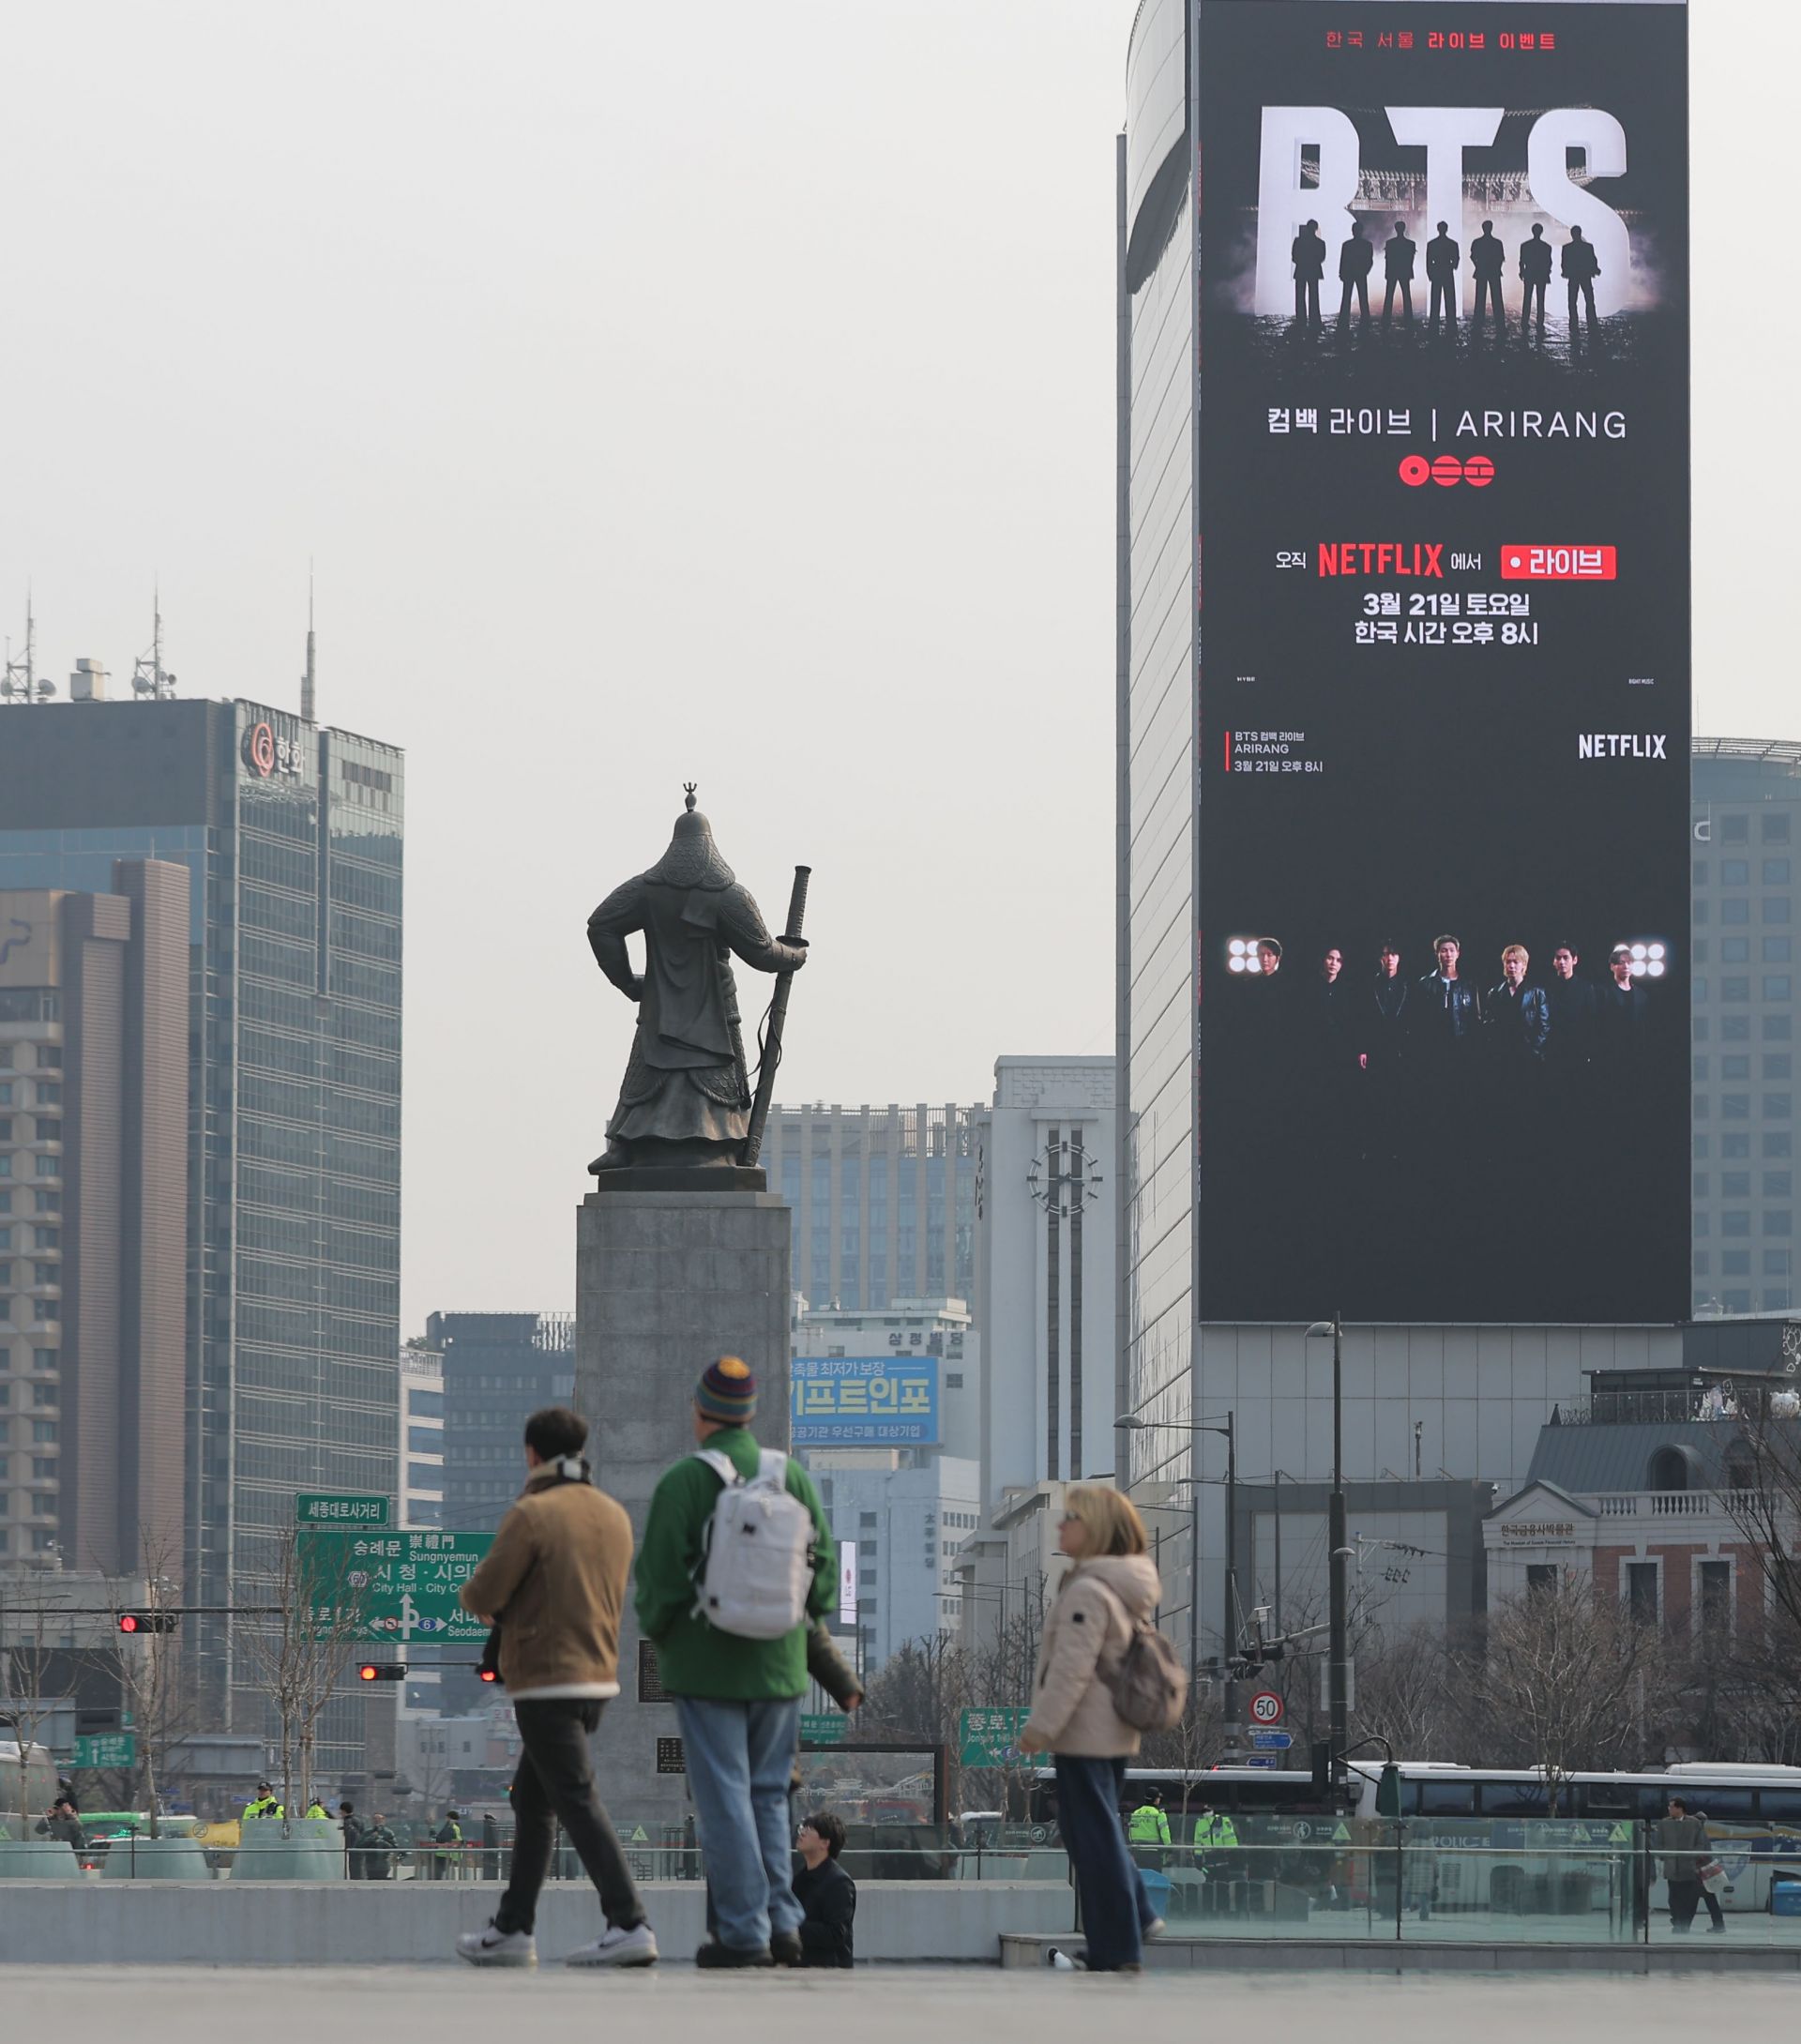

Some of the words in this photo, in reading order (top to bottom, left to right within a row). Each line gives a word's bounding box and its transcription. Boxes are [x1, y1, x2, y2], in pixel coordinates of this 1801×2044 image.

[1326, 31, 1365, 50] 한국
[1377, 31, 1415, 50] 서울
[1428, 32, 1487, 50] 라이브
[1500, 32, 1556, 51] 이벤트
[1255, 105, 1631, 317] BTS
[1267, 408, 1318, 434] 컴백
[1329, 408, 1412, 435] 라이브
[1455, 410, 1627, 439] ARIRANG
[1276, 551, 1307, 569] 오직
[1318, 543, 1444, 578] NETFLIX
[1450, 553, 1482, 570] 에서
[1529, 549, 1603, 575] 라이브
[1363, 592, 1400, 616] 3월
[1409, 593, 1460, 616] 21일
[1466, 593, 1530, 616] 토요일
[1355, 621, 1398, 644] 한국
[1404, 621, 1446, 644] 시간
[1452, 621, 1494, 644] 오후
[1501, 621, 1539, 645] 8시
[1234, 732, 1258, 742] BTS
[1261, 731, 1278, 742] 컴백
[1279, 731, 1305, 742] 라이브
[1234, 744, 1290, 754] ARIRANG
[1579, 734, 1667, 760] NETFLIX
[276, 735, 305, 778] 한화
[1234, 761, 1252, 772] 3월
[1255, 761, 1279, 772] 21일
[1281, 761, 1303, 772] 오후
[1305, 761, 1323, 773] 8시
[790, 1362, 819, 1377] 촉물
[821, 1362, 858, 1376] 최저가
[859, 1361, 885, 1376] 보장
[878, 1425, 921, 1438] 대상기업
[308, 1502, 381, 1520] 세종대로사거리
[353, 1539, 401, 1557] 숭례문
[409, 1534, 455, 1550] 崇禮門
[409, 1551, 478, 1564] Sungnyemun
[434, 1564, 481, 1581] 시의
[372, 1582, 394, 1595] City
[397, 1582, 416, 1593] Hall
[426, 1582, 447, 1595] City
[423, 1620, 431, 1630] 6
[448, 1608, 481, 1625] 서대
[447, 1626, 492, 1638] Seodaem
[1257, 1700, 1276, 1717] 50
